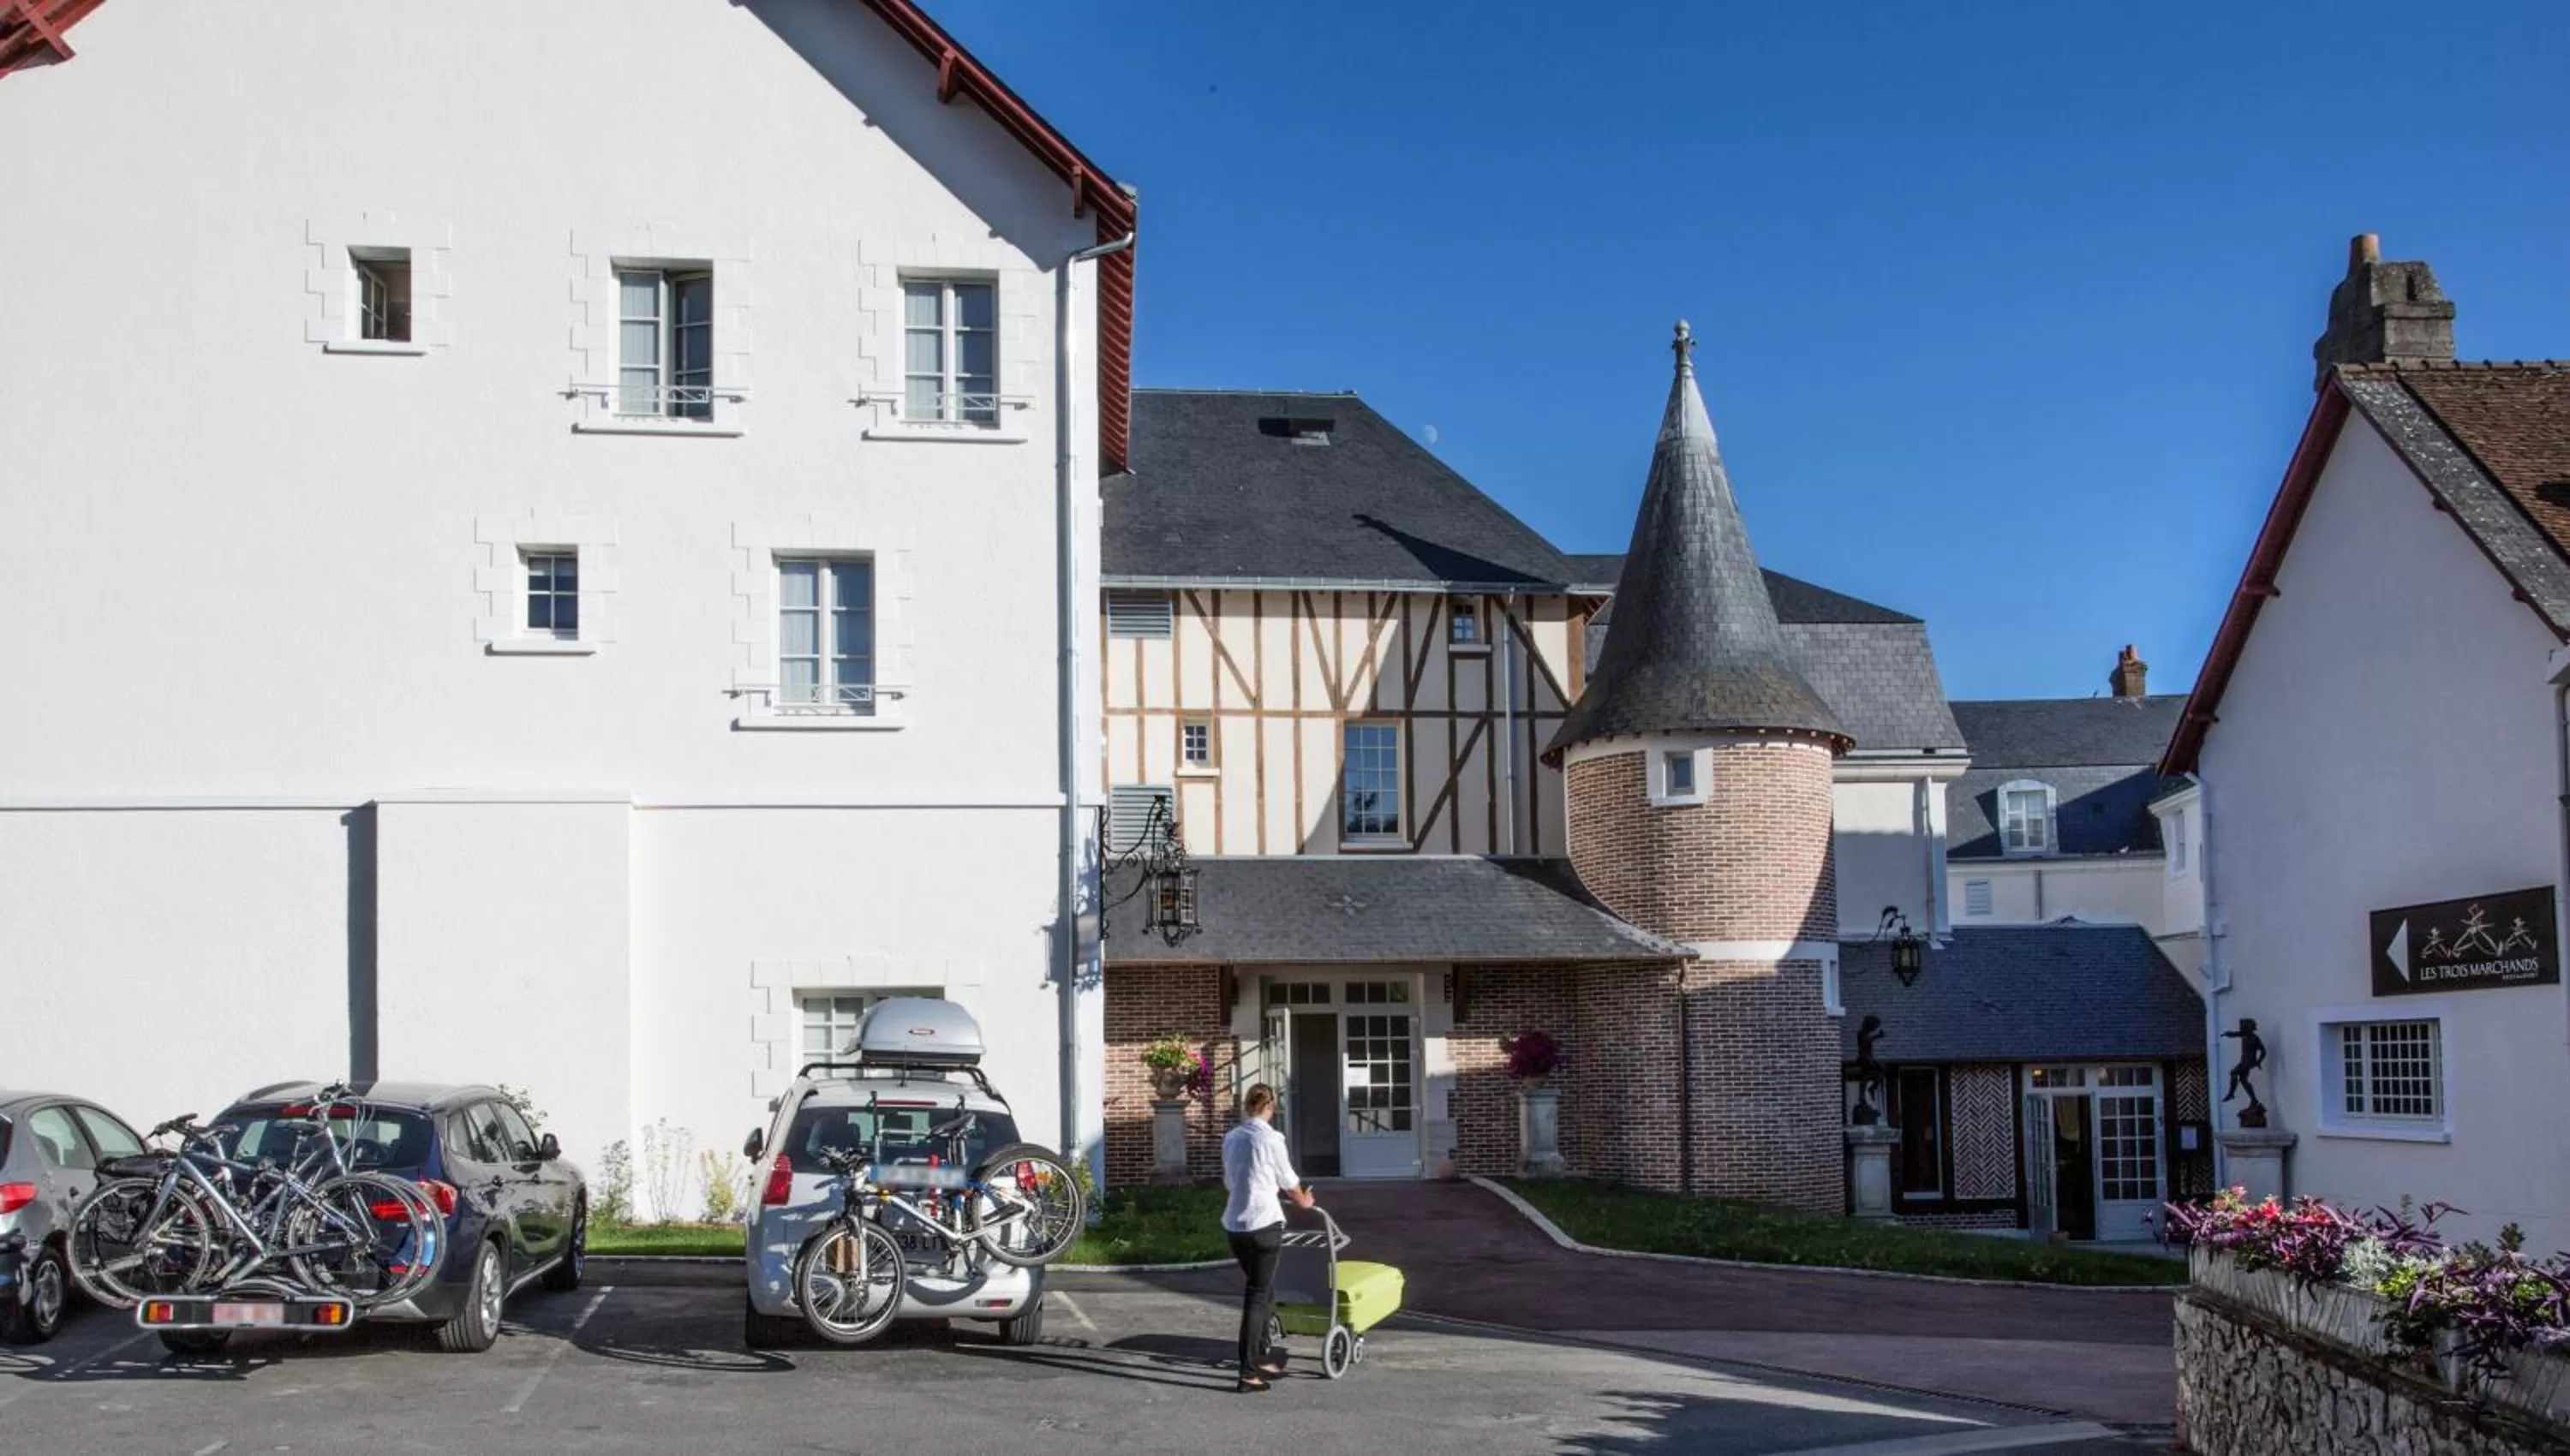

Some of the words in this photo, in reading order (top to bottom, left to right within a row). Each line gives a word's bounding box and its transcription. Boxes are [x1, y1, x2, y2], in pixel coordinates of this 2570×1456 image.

[2421, 967, 2436, 980] LES
[2439, 964, 2468, 978] TROIS
[2470, 957, 2537, 975] MARCHANDS
